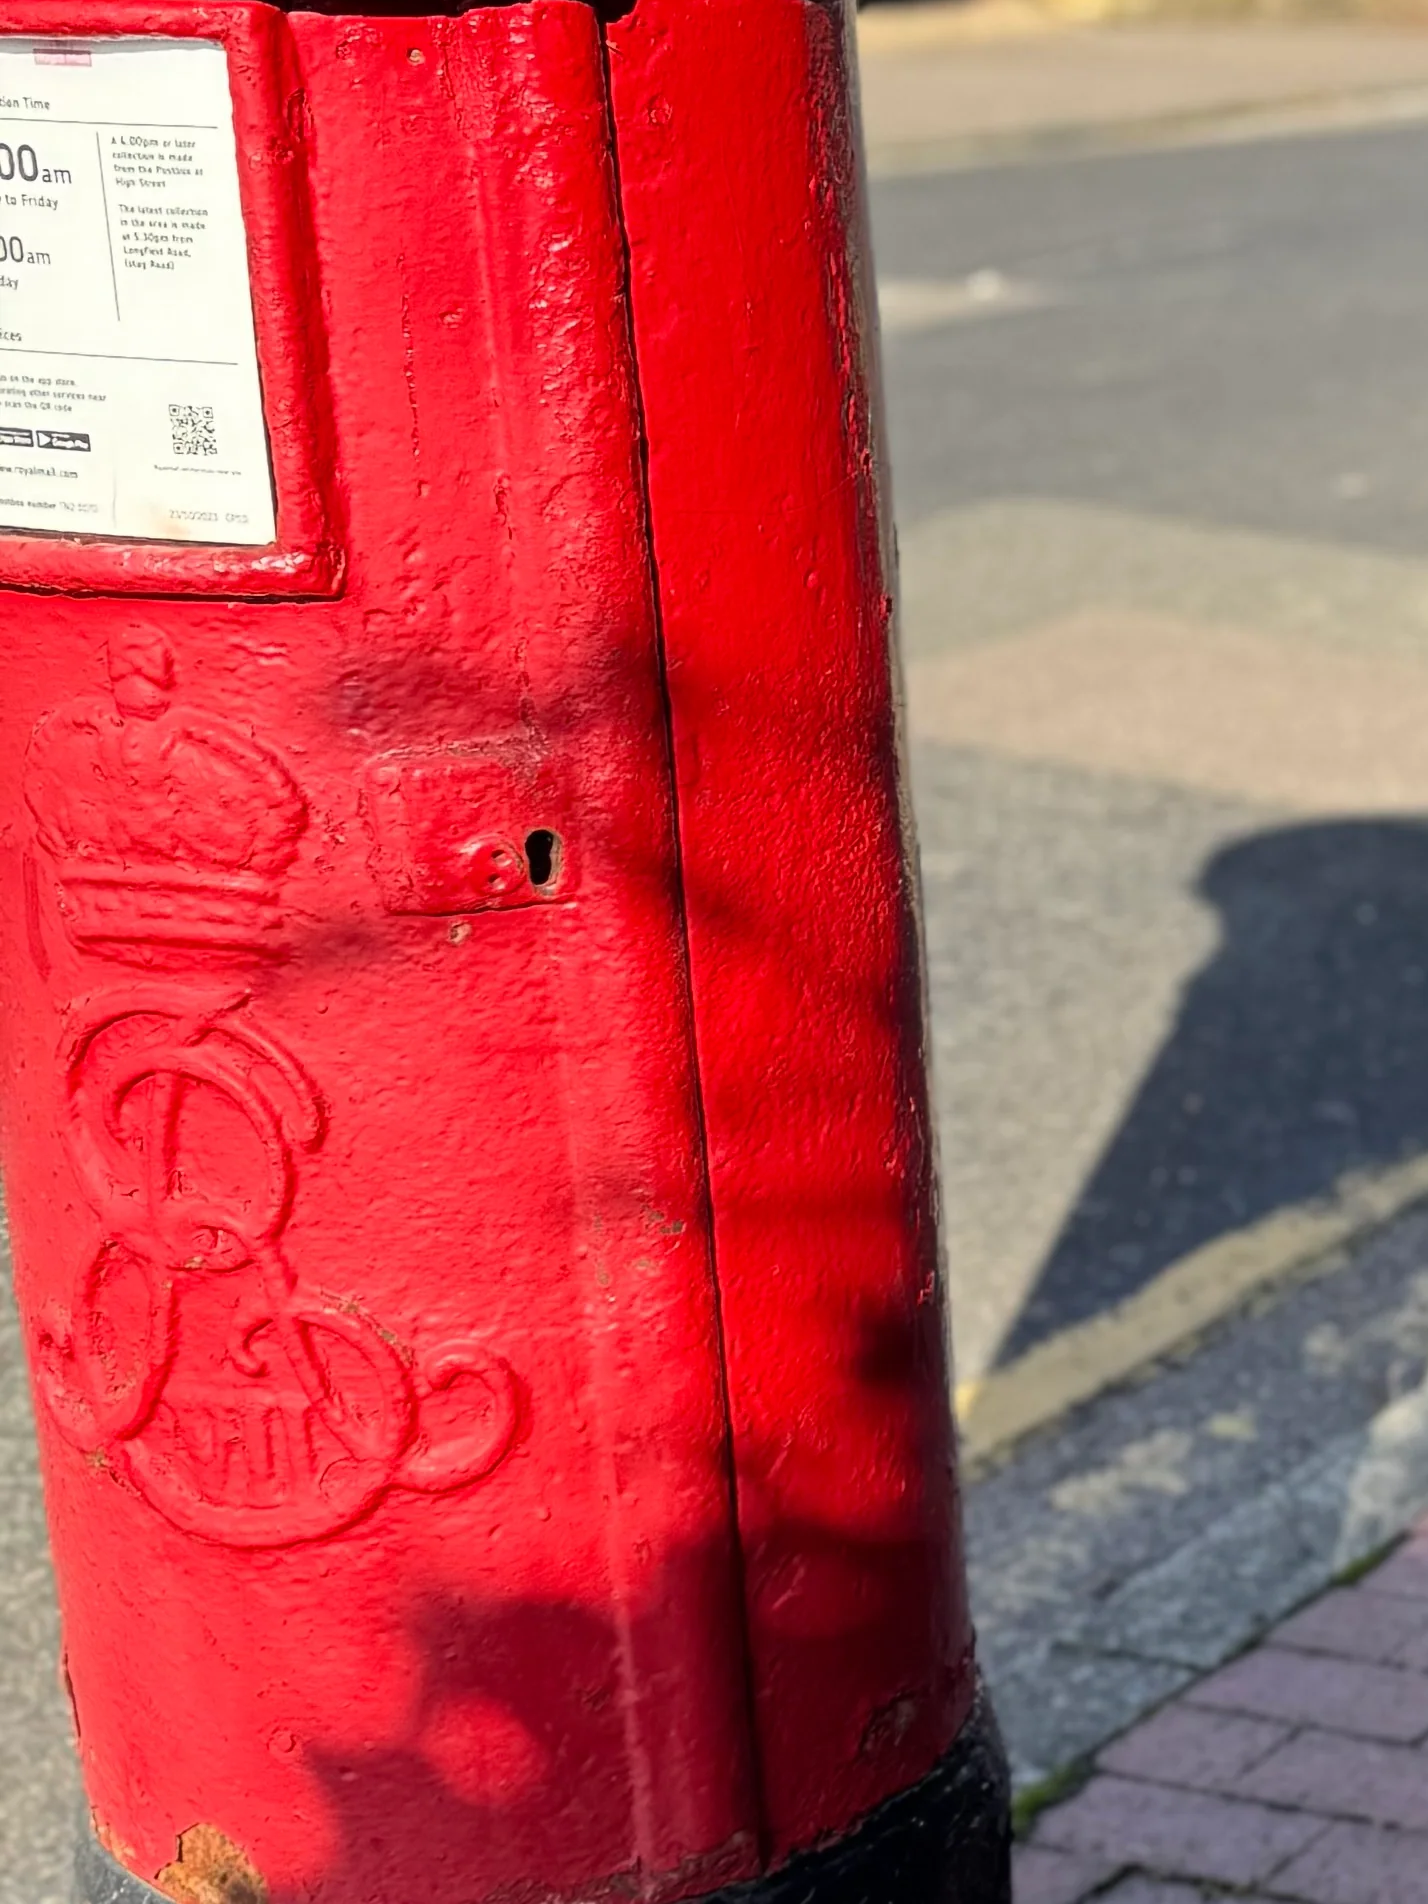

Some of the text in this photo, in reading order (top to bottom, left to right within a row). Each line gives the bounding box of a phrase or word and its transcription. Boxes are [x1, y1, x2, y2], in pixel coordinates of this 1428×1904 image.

[23, 96, 50, 110] Time
[5, 194, 17, 206] to
[21, 194, 58, 211] Friday
[118, 204, 134, 214] The
